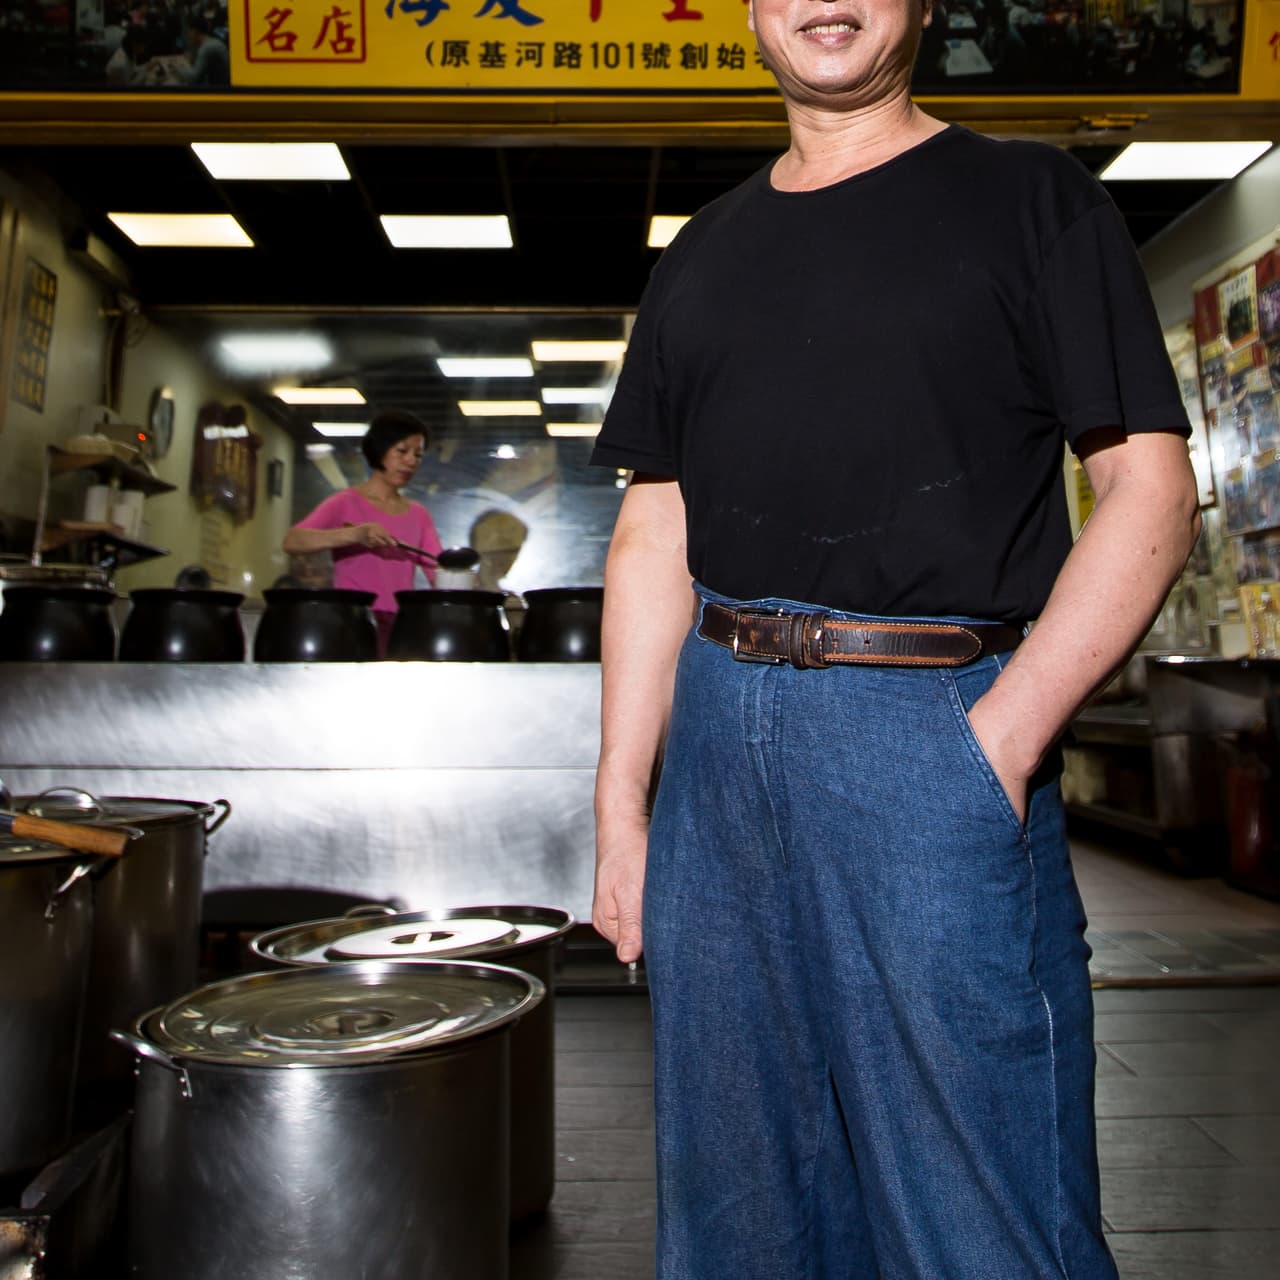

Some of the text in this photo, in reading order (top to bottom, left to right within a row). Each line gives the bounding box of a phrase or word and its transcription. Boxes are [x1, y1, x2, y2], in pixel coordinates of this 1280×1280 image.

[424, 41, 770, 71] (原基河路101號創始
